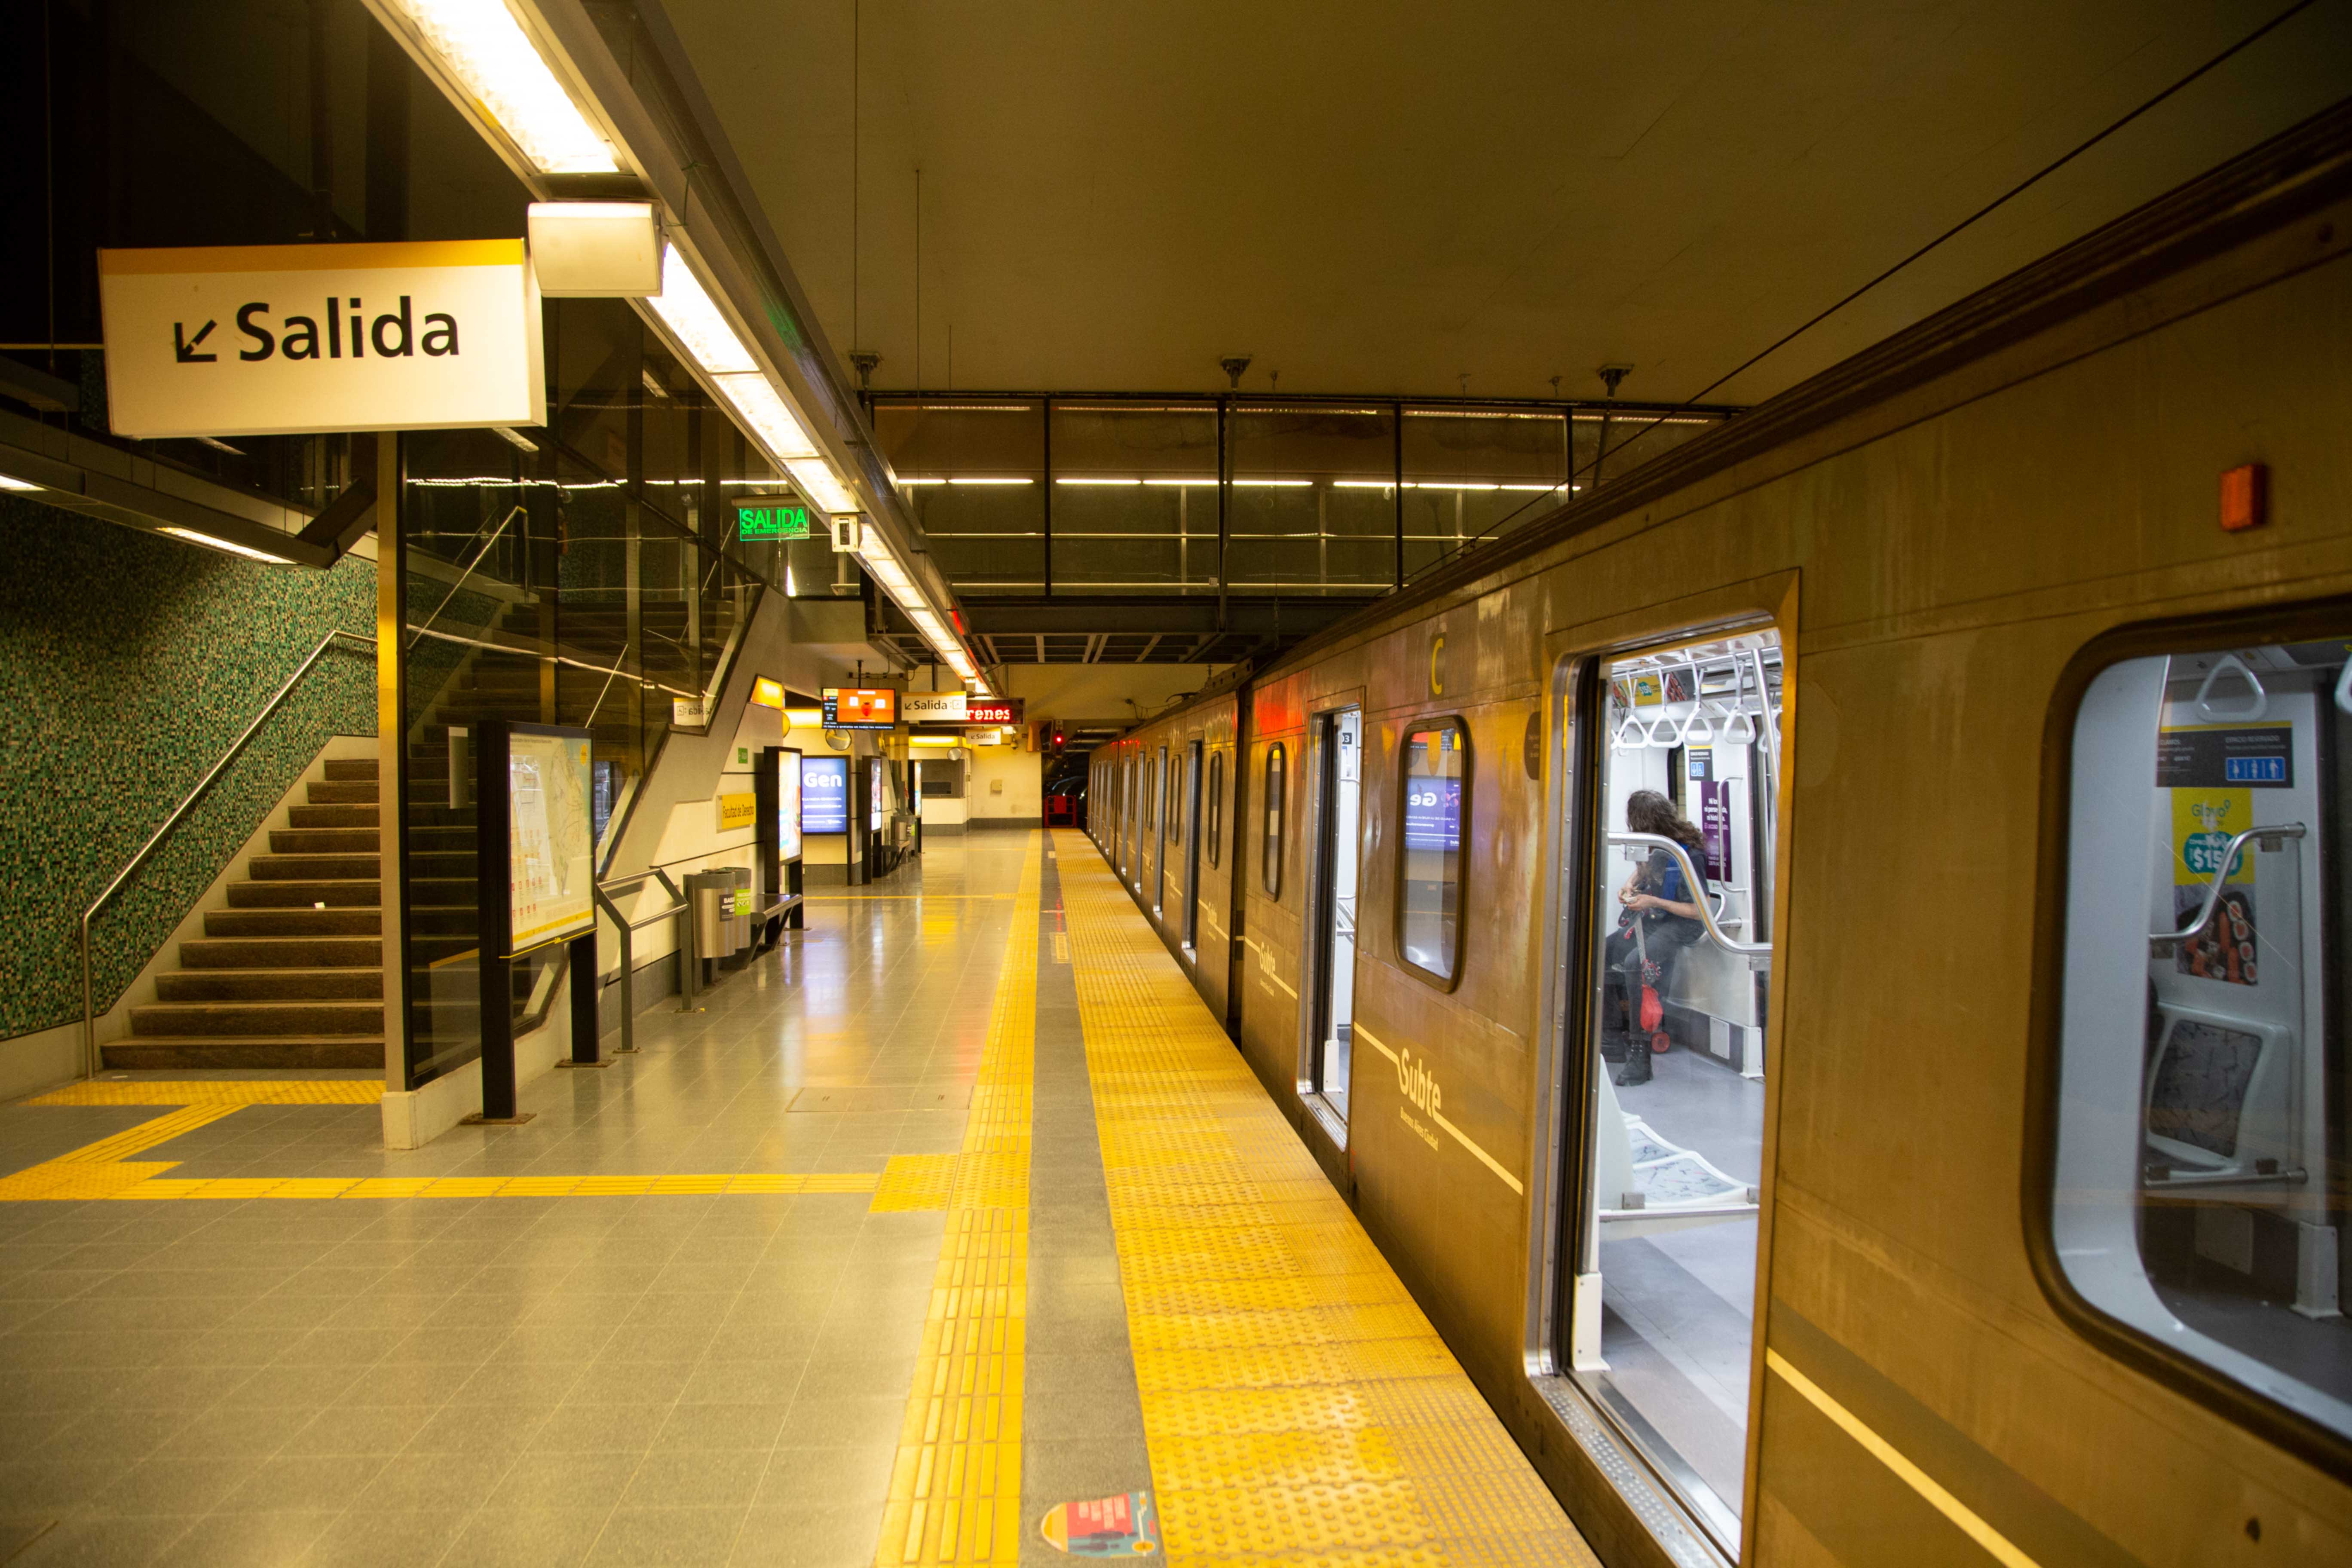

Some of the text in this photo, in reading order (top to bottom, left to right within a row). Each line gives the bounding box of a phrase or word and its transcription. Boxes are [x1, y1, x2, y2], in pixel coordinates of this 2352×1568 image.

[236, 295, 459, 362] Salida
[742, 508, 807, 529] SALIDA
[1431, 638, 1443, 695] C
[914, 700, 947, 710] Salida
[966, 709, 1010, 720] renes
[804, 772, 842, 787] Gen
[723, 801, 754, 818] Facultad de Derecho
[1260, 942, 1275, 977] Subte
[1400, 1047, 1441, 1119] Subte
